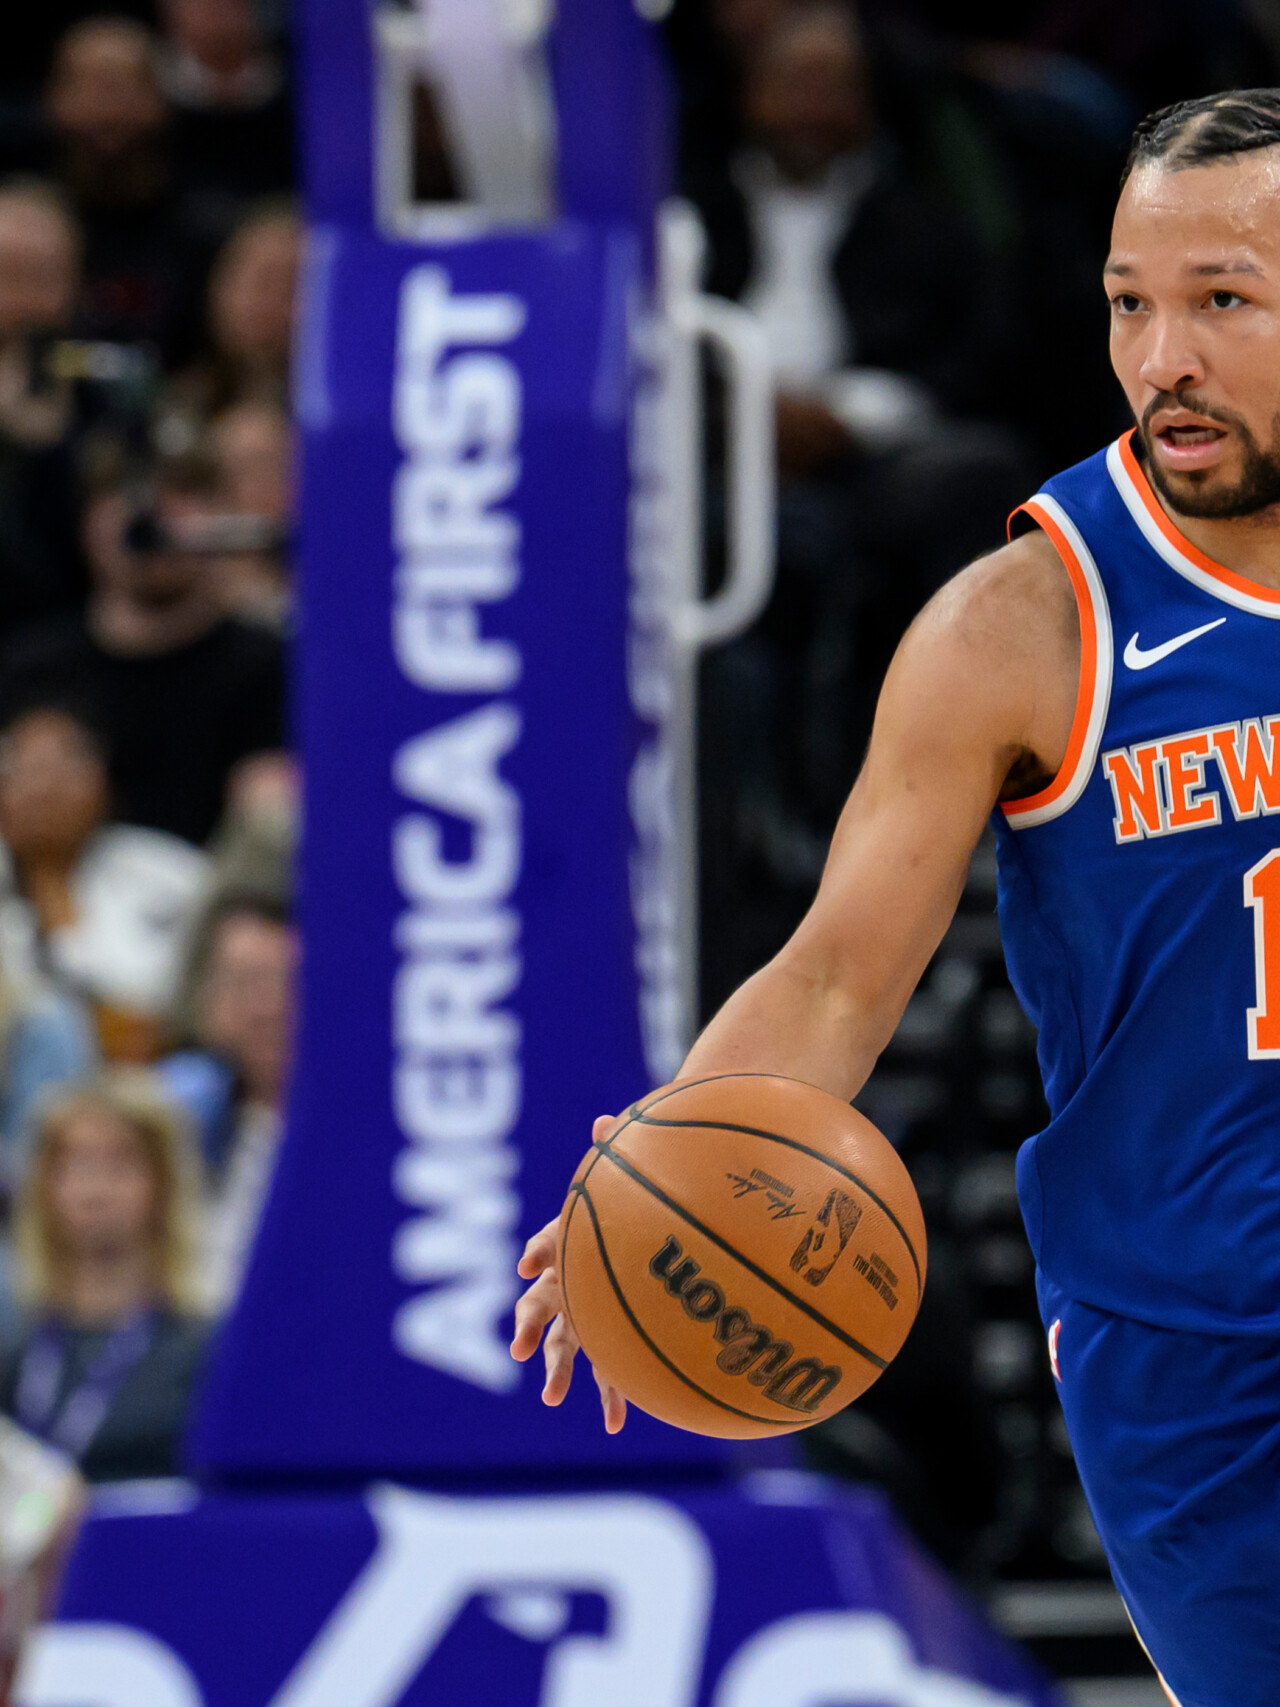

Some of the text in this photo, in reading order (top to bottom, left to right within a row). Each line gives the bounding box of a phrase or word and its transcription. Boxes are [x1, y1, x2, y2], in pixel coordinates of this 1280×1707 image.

[392, 262, 528, 1396] AMERICA FIRST
[648, 1233, 843, 1414] Wilson
